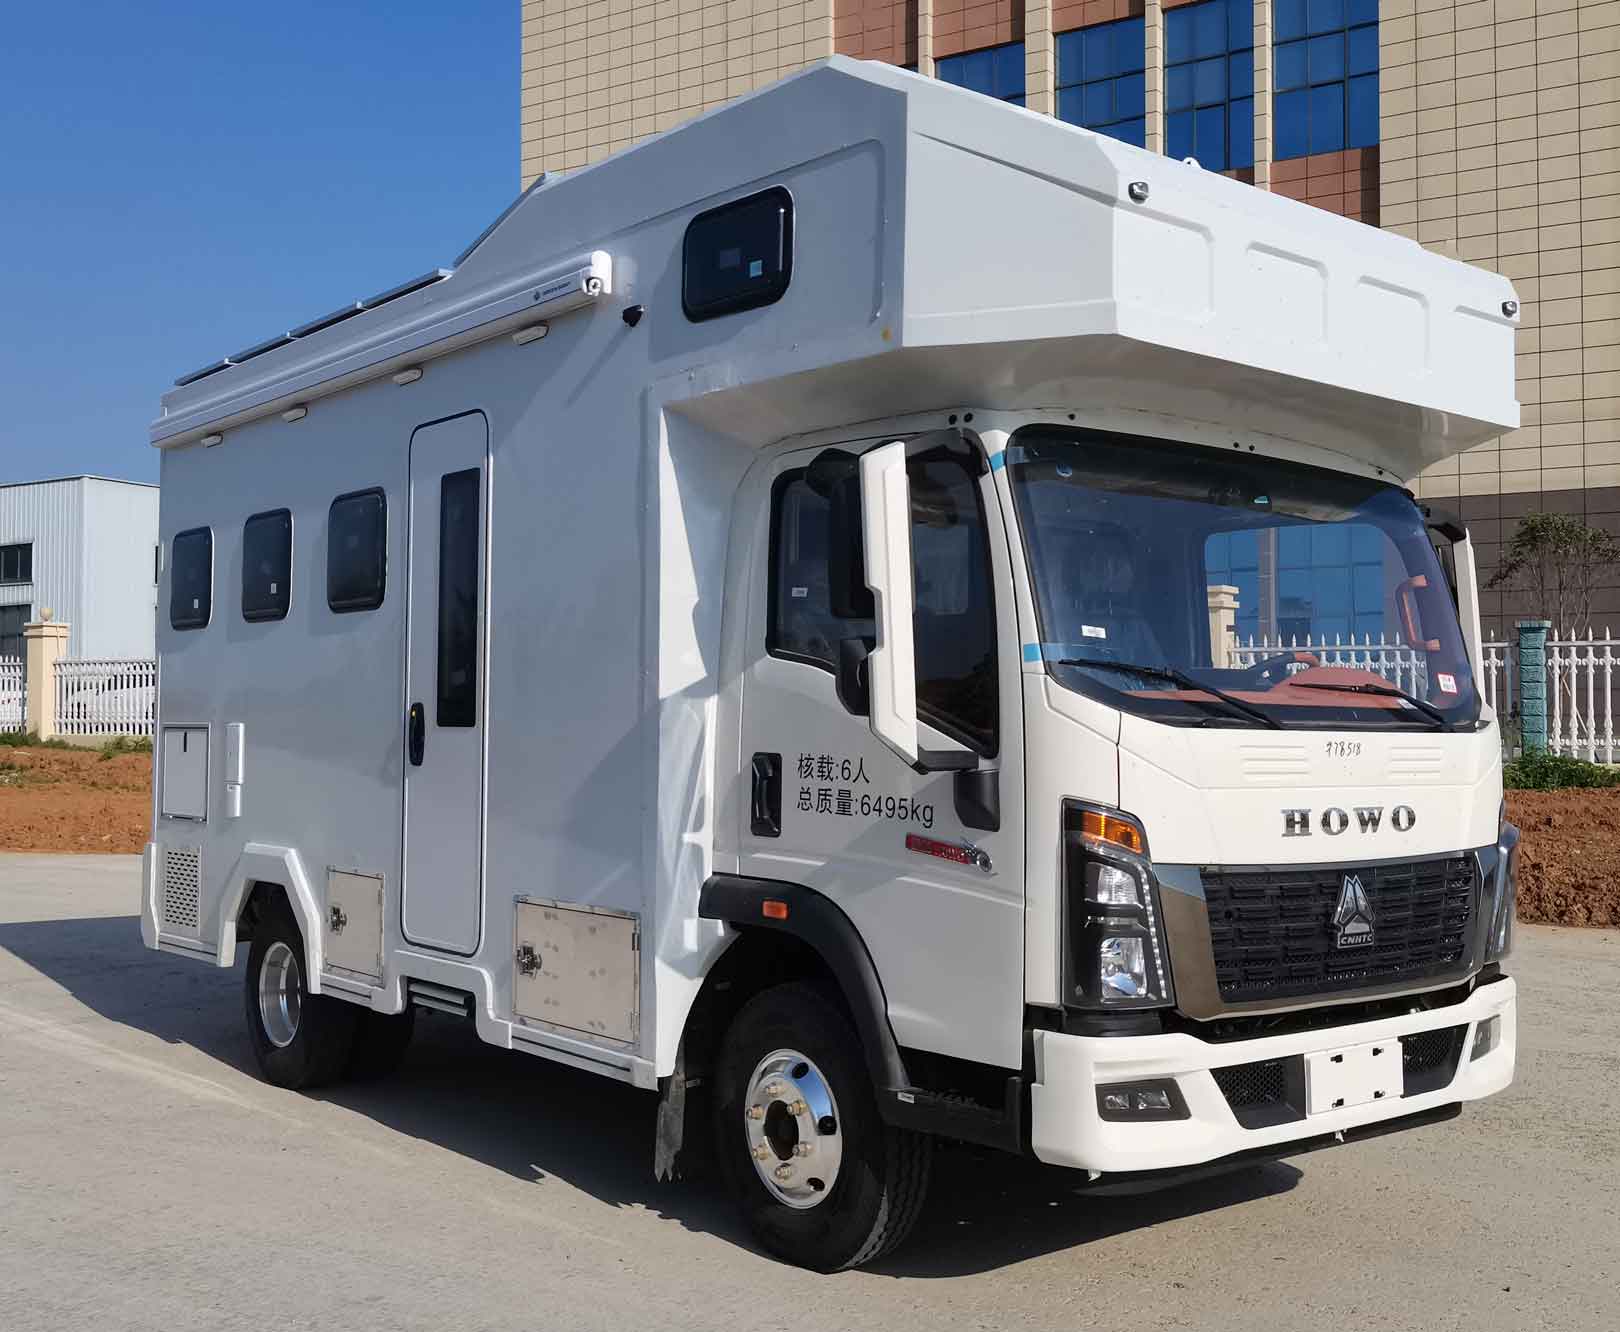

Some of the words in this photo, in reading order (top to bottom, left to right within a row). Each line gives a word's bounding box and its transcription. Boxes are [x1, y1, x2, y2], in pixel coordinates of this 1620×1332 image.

[797, 753, 870, 784] 核载:6人
[797, 787, 934, 828] 总质量:6495kg
[1281, 805, 1416, 837] HOWO
[1341, 934, 1372, 945] CNHTC
